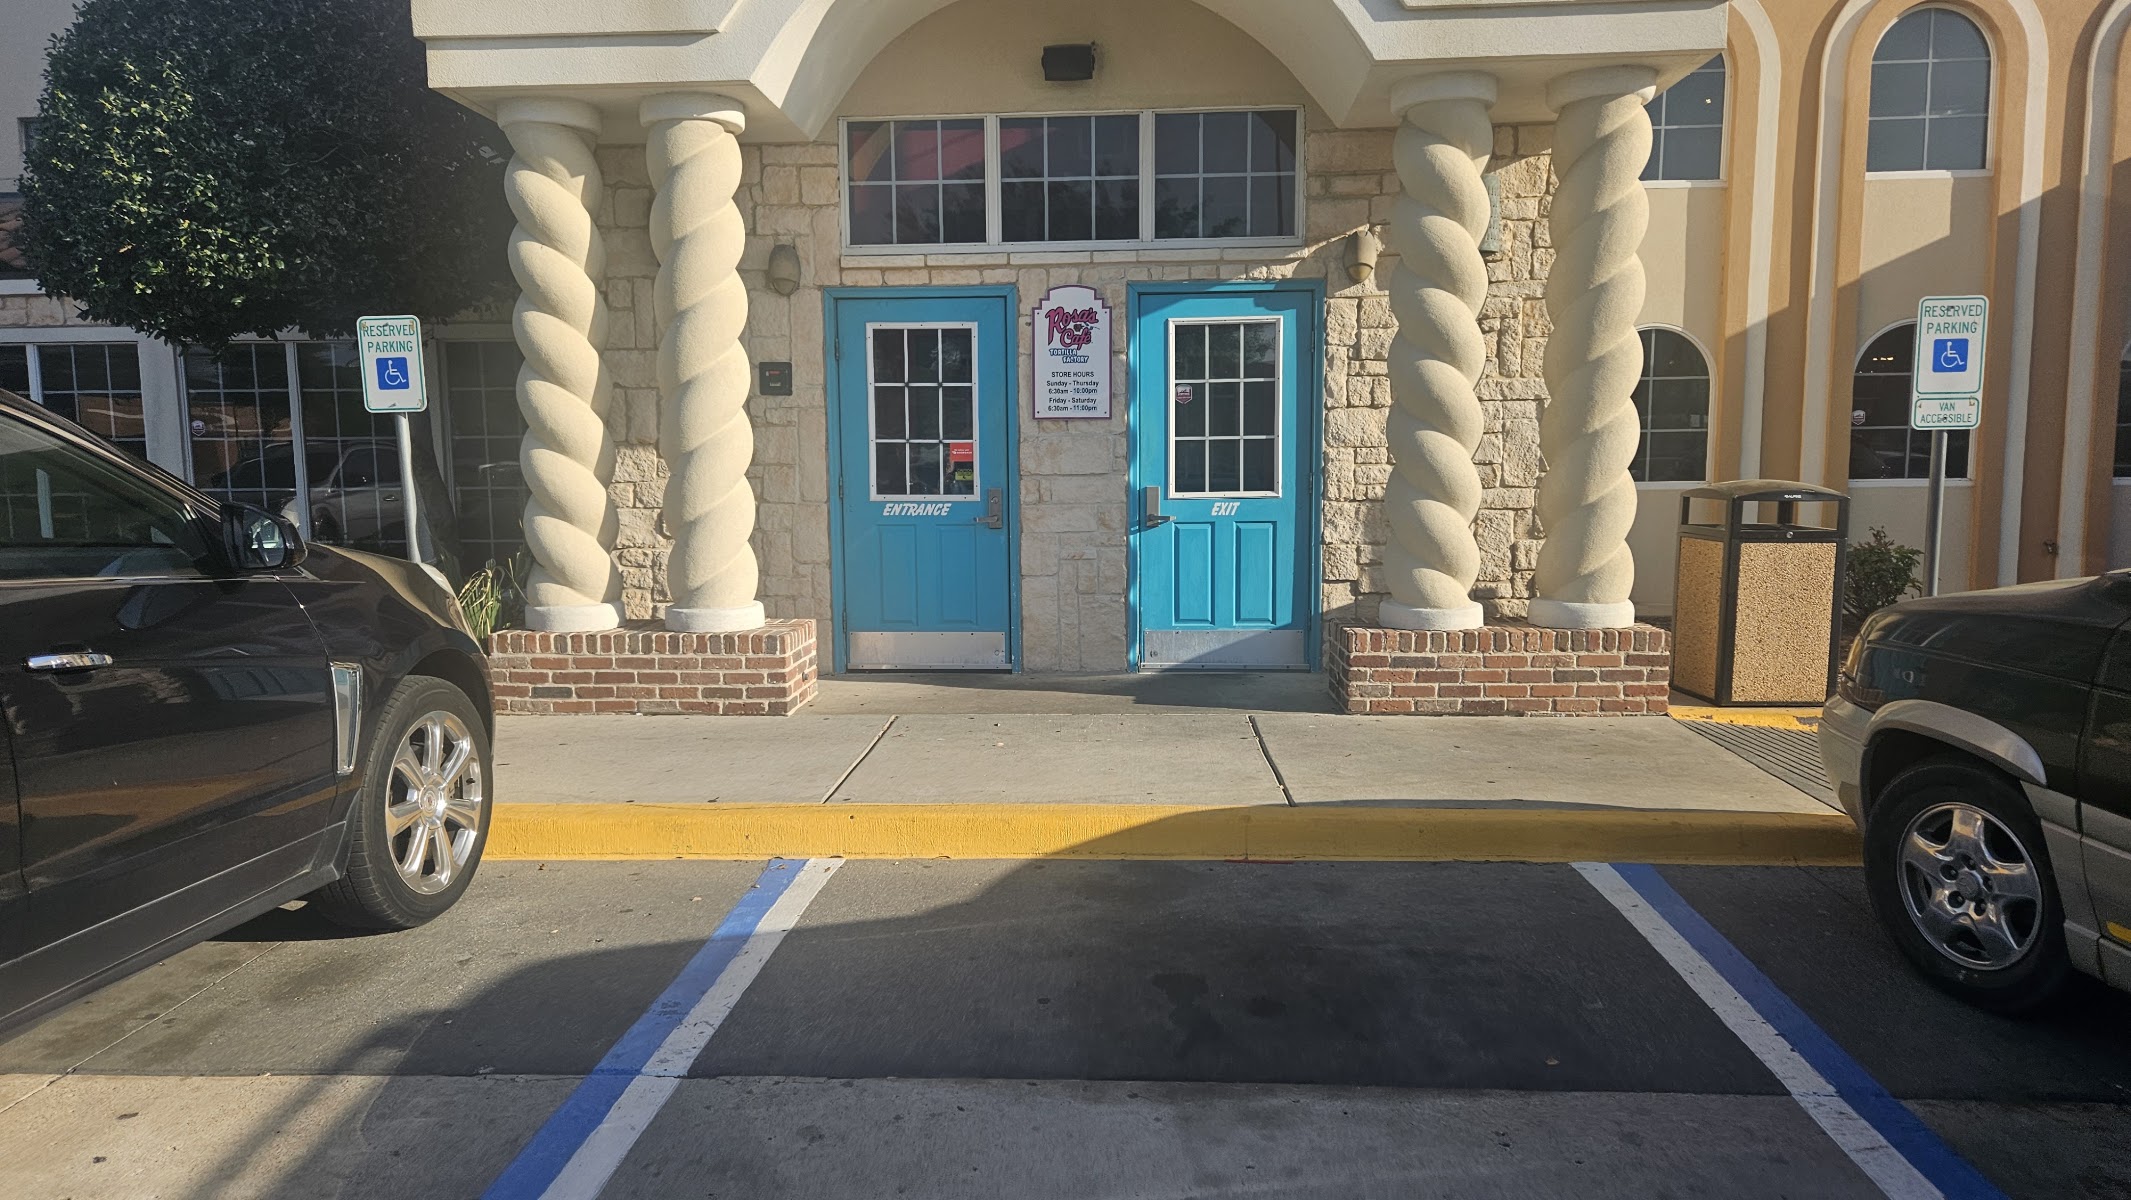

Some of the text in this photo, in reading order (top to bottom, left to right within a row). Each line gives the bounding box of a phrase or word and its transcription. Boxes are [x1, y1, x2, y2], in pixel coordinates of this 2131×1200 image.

[1924, 304, 1983, 318] RESERVED
[363, 324, 415, 337] RESERVED
[1045, 306, 1099, 346] Rosa's
[1926, 321, 1978, 334] PARKING
[1060, 327, 1092, 350] Café
[367, 340, 413, 353] PARKING
[1049, 348, 1077, 356] TORTILLA
[1062, 355, 1089, 363] FACTORY
[1939, 401, 1956, 411] VAN
[1920, 413, 1973, 423] ACCESSIBLE
[882, 503, 952, 516] ENTRANCE
[1211, 502, 1241, 516] EXIT
